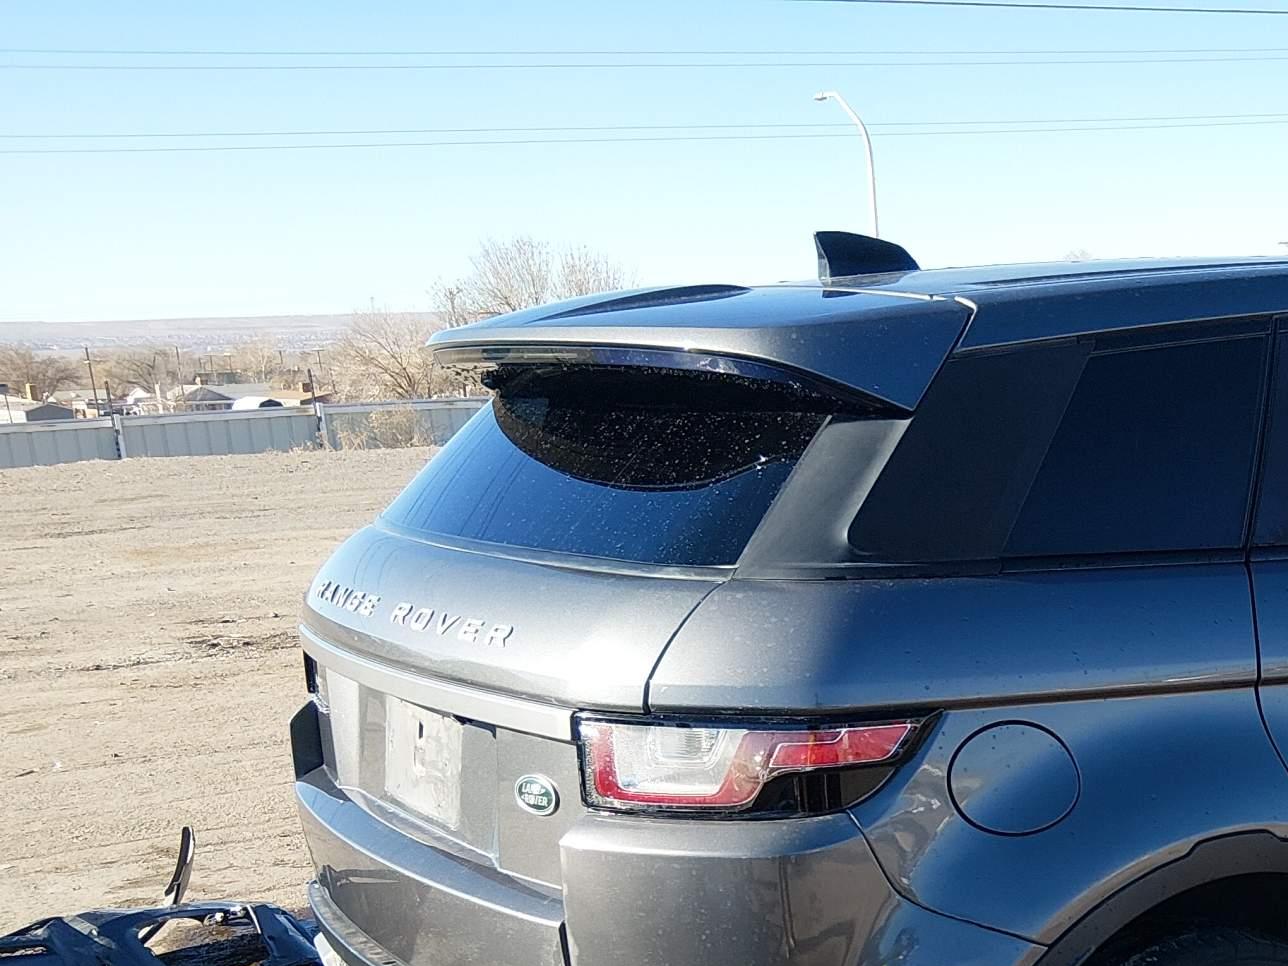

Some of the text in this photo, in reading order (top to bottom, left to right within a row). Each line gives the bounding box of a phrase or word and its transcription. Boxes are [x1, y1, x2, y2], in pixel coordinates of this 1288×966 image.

[316, 581, 514, 648] RANGE ROVER
[521, 782, 543, 795] LAND
[522, 793, 549, 807] ROVER
